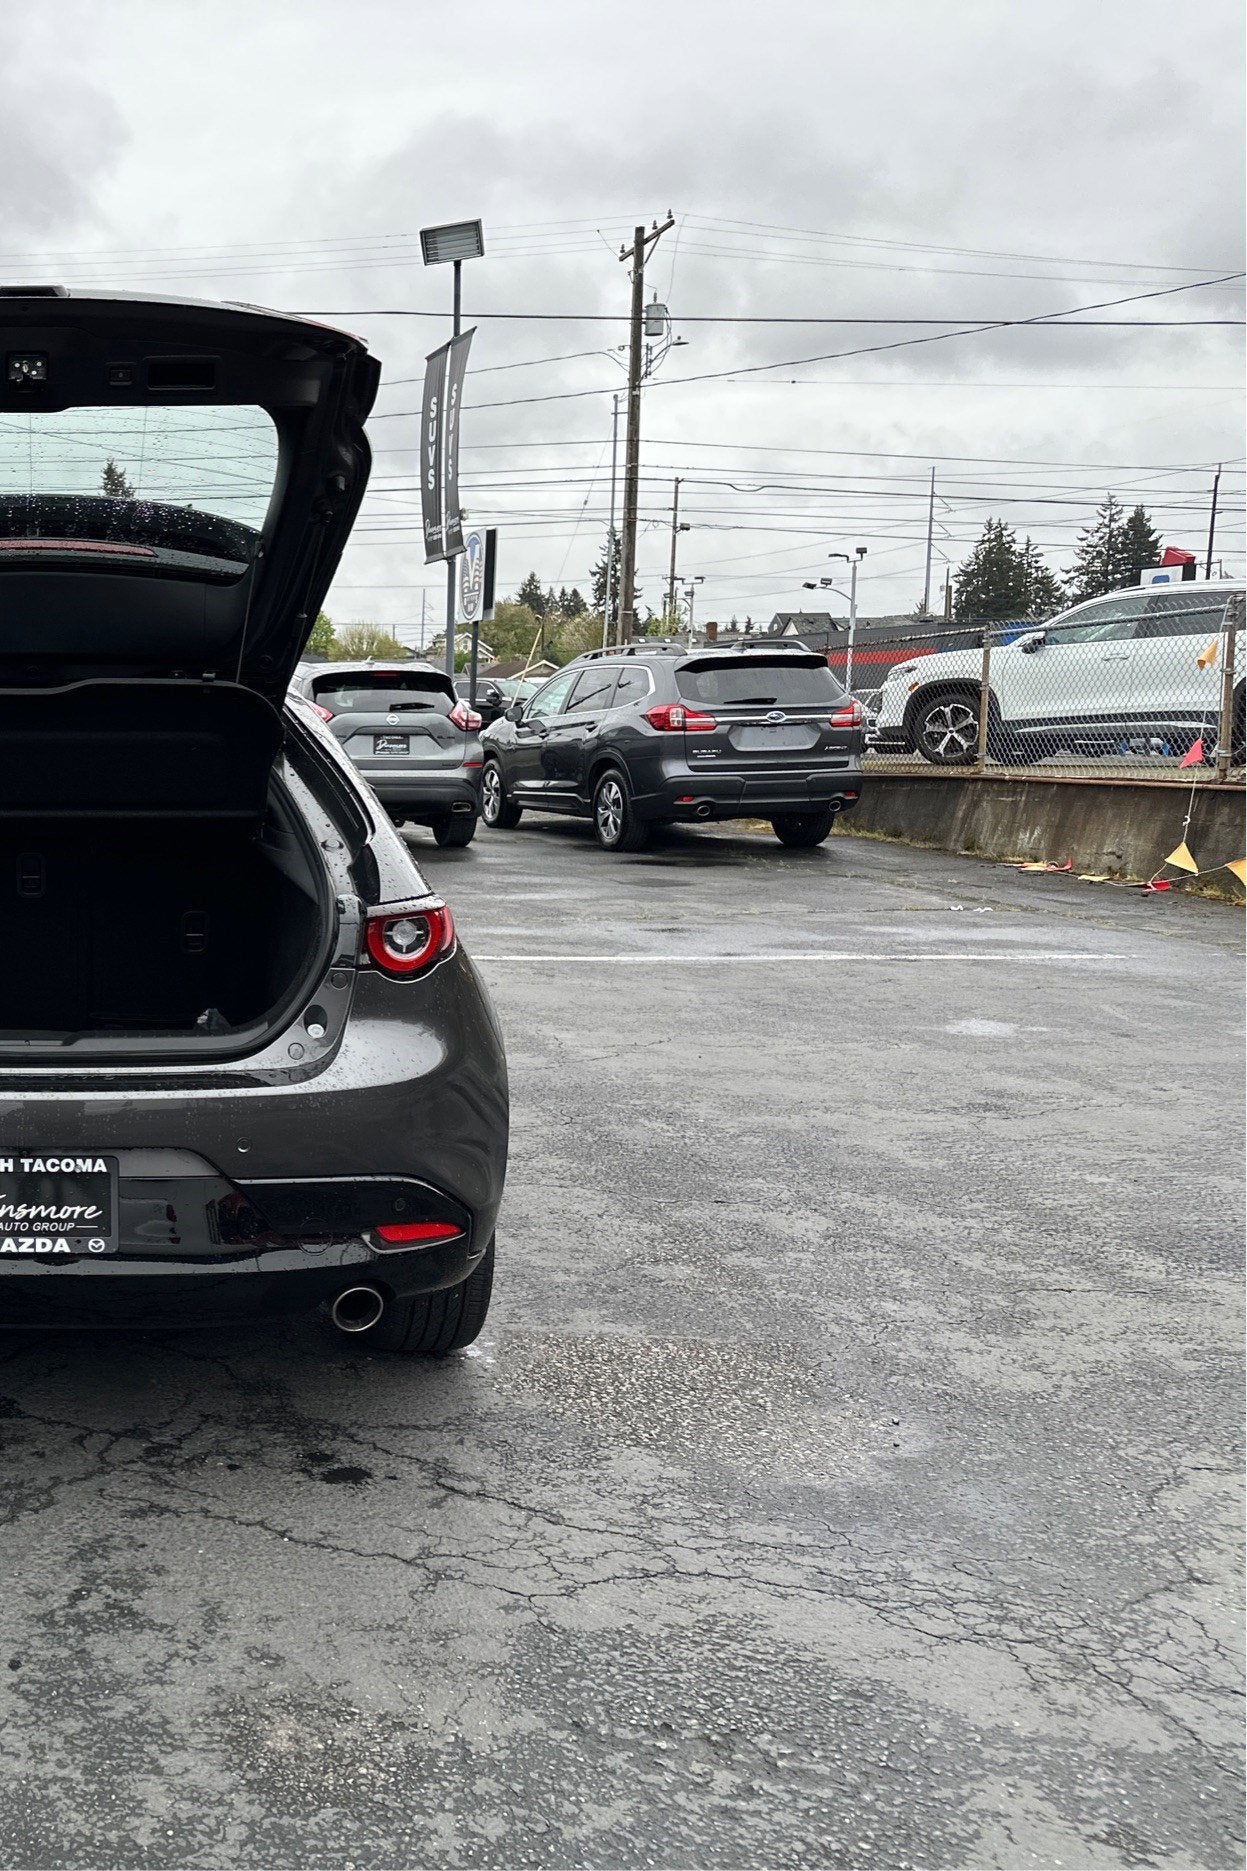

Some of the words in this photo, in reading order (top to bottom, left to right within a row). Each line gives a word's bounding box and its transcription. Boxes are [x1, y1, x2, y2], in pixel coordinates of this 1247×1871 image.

[428, 396, 438, 490] SUVS
[448, 383, 457, 480] SUVS
[20, 1158, 107, 1173] TACOMA
[33, 1222, 75, 1232] GROUP
